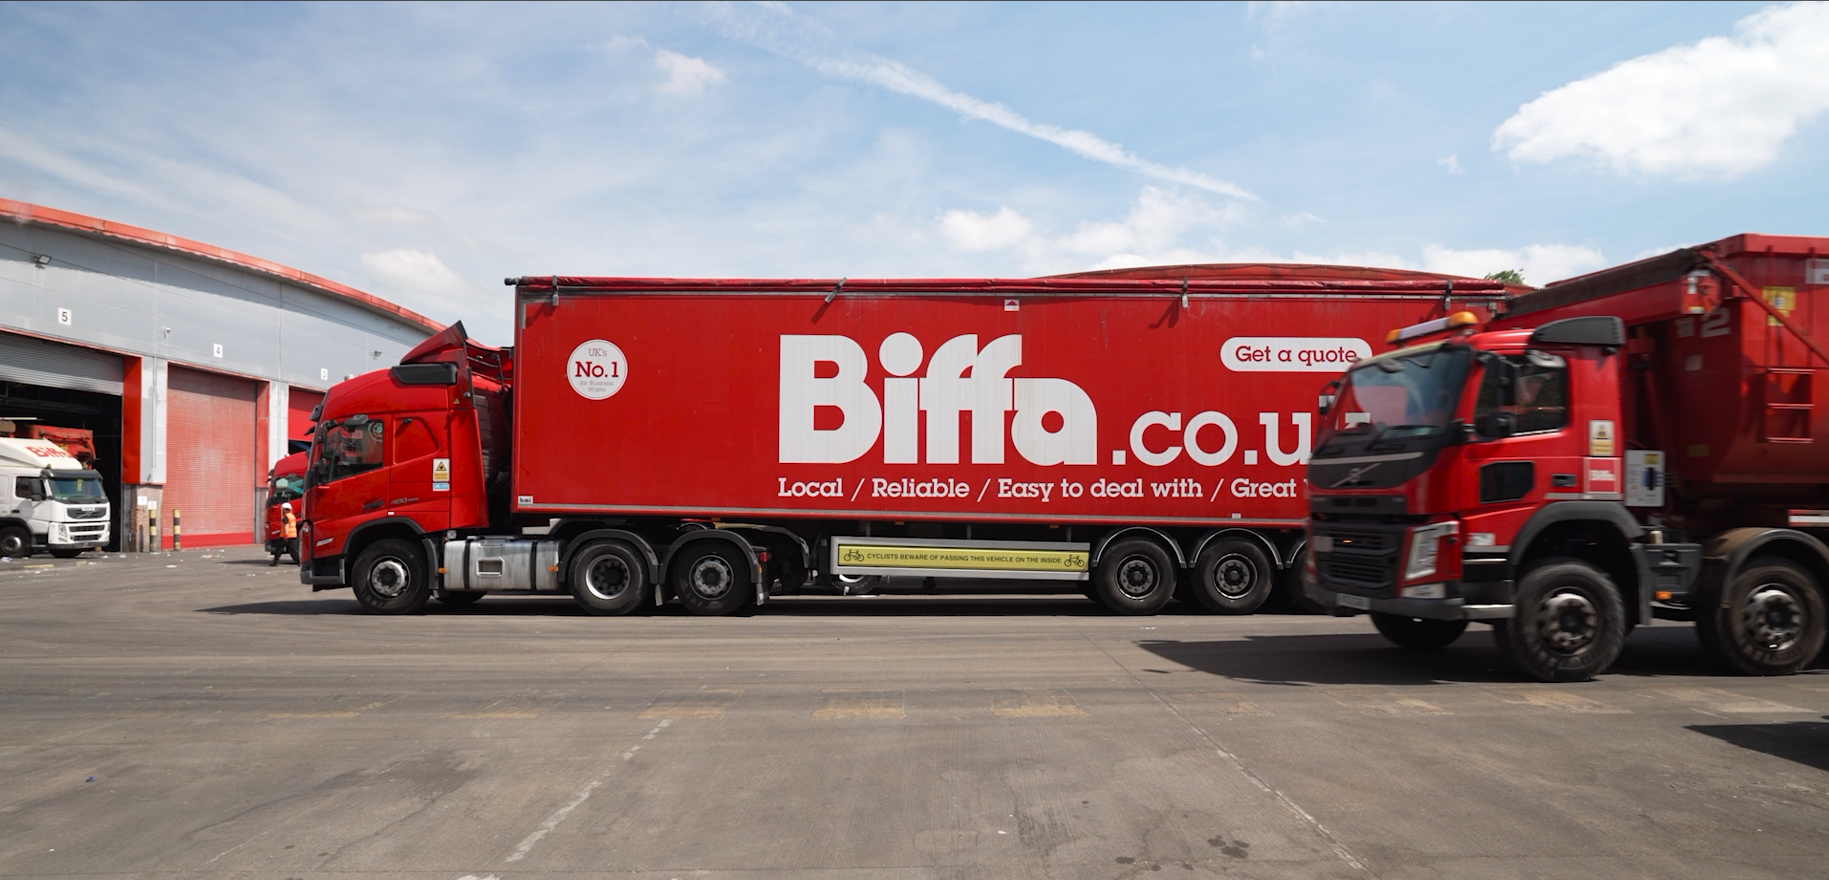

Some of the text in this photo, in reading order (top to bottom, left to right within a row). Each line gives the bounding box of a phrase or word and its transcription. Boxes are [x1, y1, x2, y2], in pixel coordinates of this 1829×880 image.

[62, 311, 68, 322] 5
[216, 346, 221, 355] 4
[588, 348, 608, 357] UK's
[1235, 346, 1358, 366] Get a quote
[779, 332, 1097, 466] Biffa
[778, 478, 843, 498] Local
[872, 478, 970, 498] Reliable
[998, 479, 1054, 502] Easy
[1061, 479, 1084, 498] to
[1091, 479, 1144, 498] deal
[1151, 479, 1204, 498] with
[1231, 478, 1297, 498] Great
